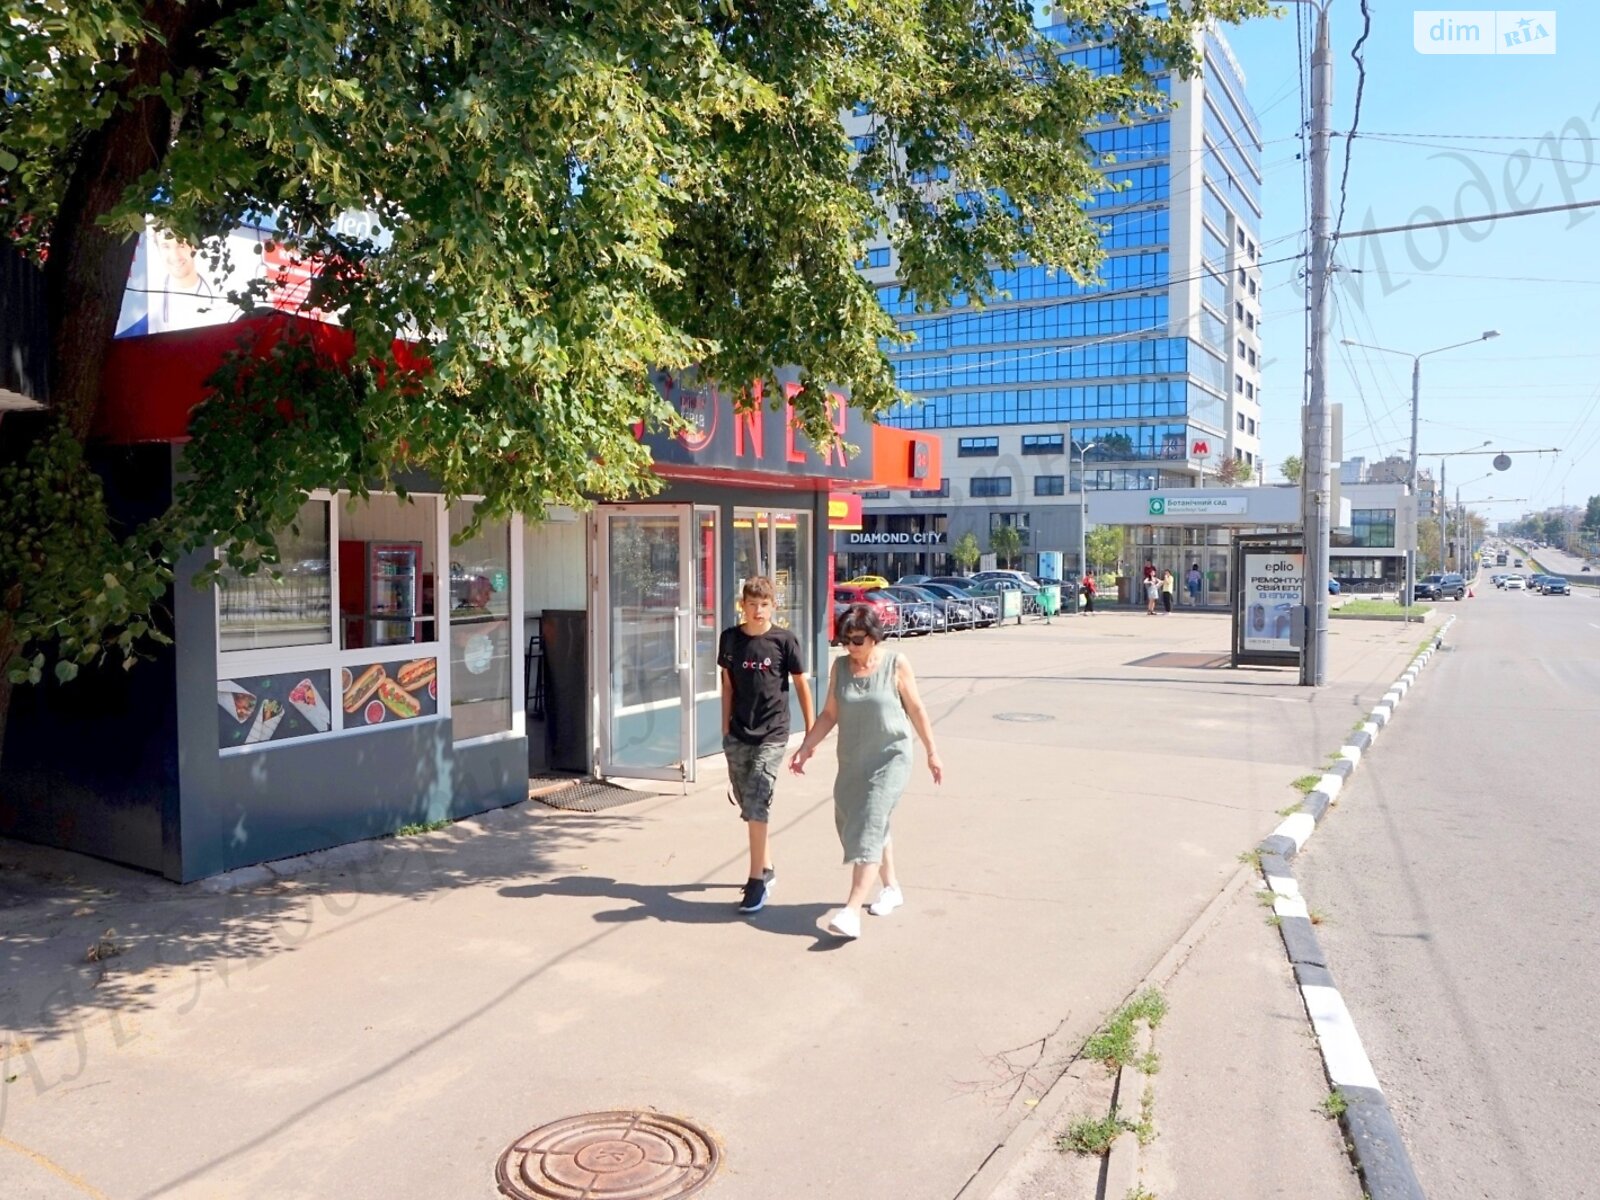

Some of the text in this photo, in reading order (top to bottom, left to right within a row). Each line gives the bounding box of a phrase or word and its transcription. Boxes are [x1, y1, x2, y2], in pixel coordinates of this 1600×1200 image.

[850, 533, 942, 543] DIAMOND CITY
[1265, 561, 1294, 573] eplio
